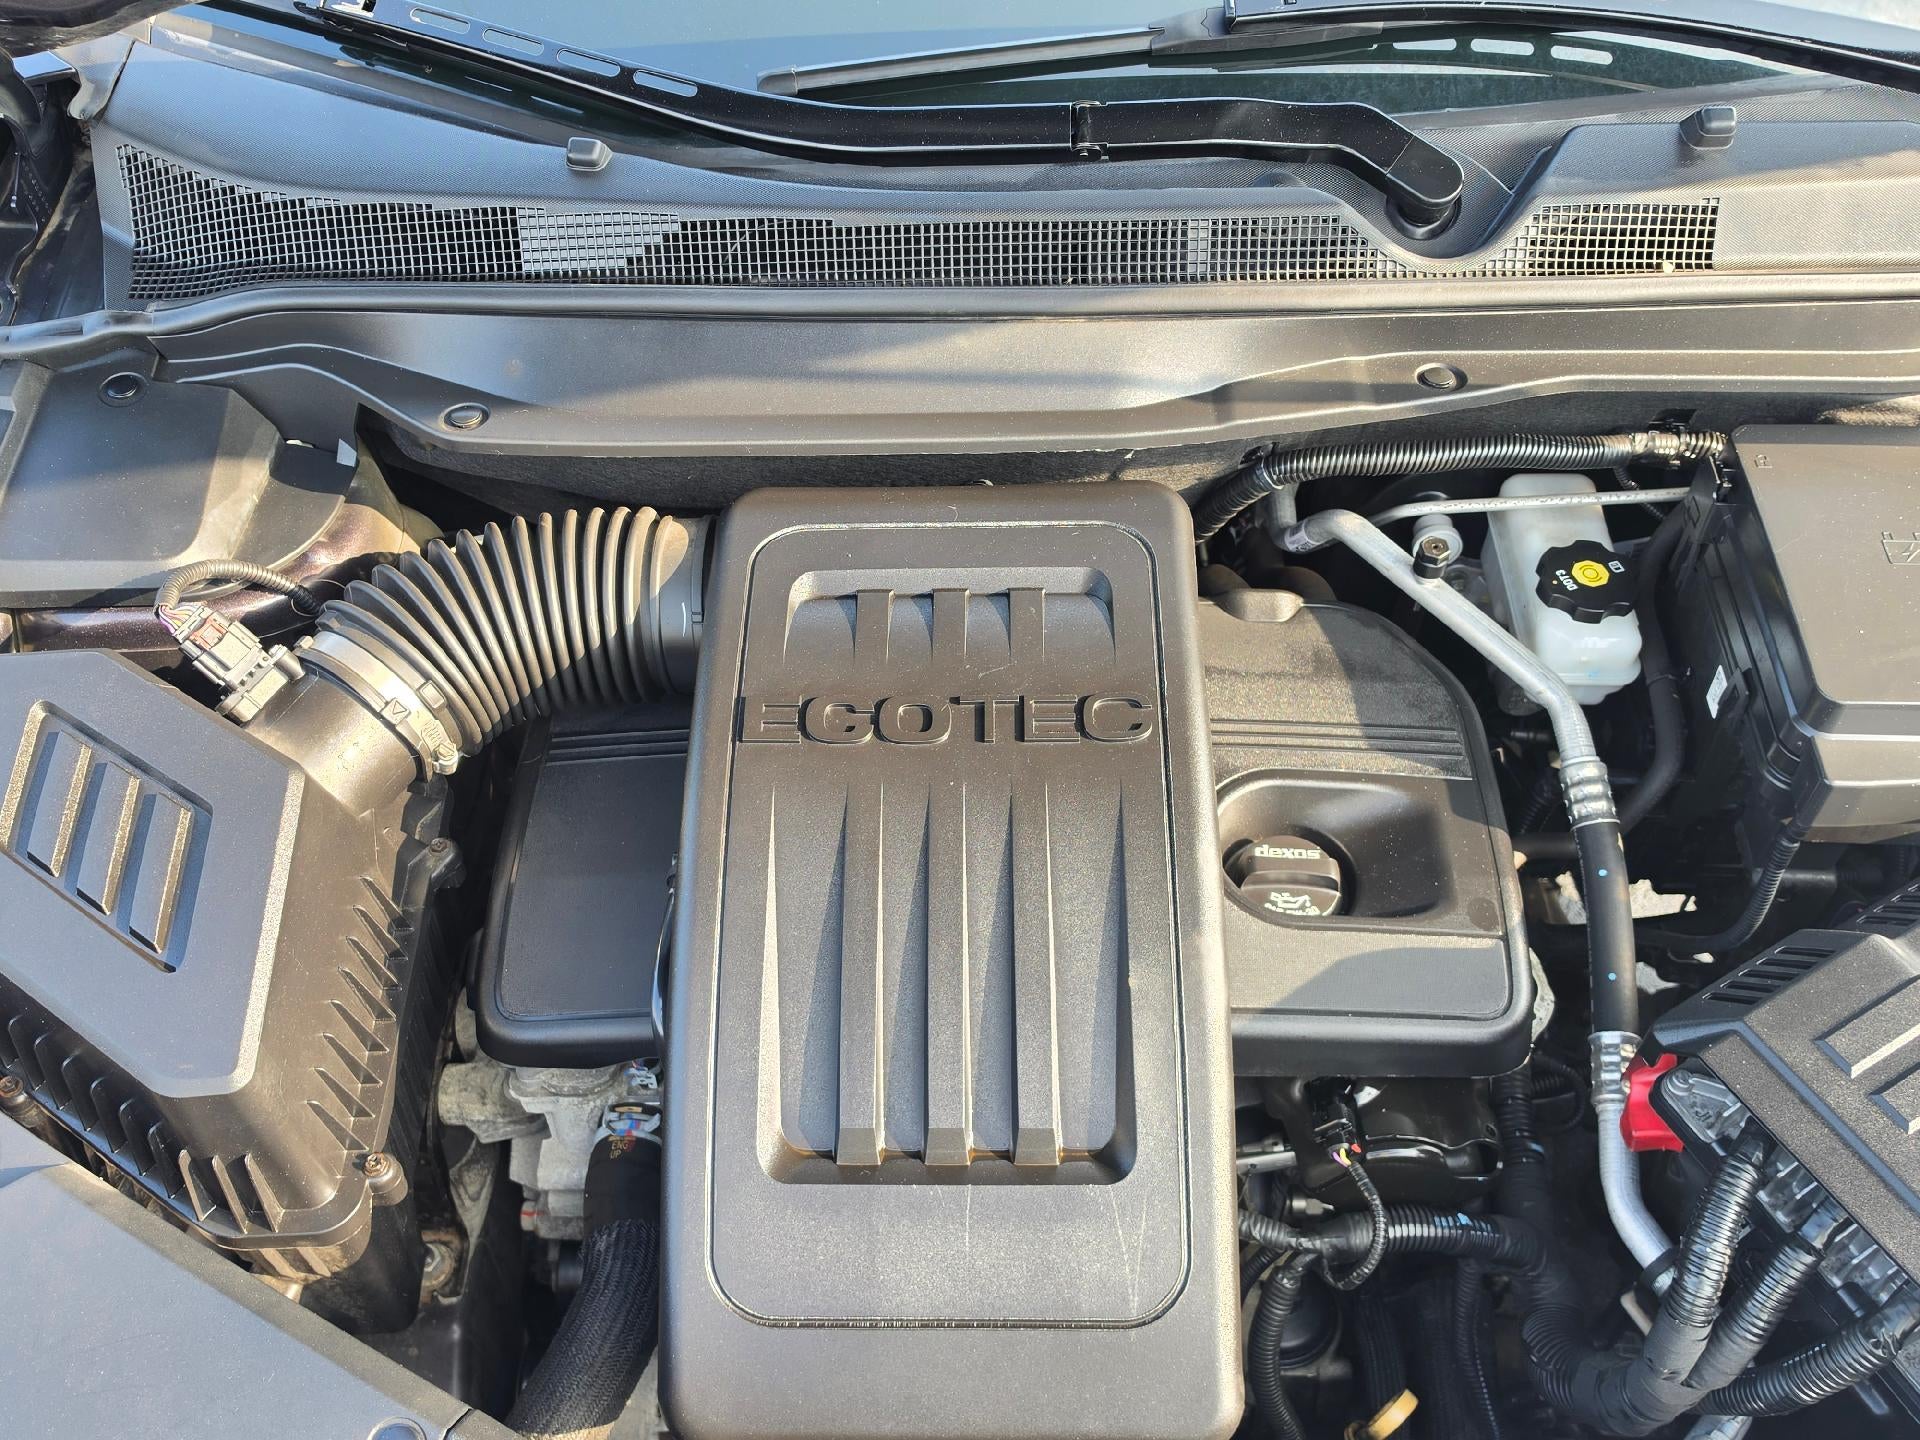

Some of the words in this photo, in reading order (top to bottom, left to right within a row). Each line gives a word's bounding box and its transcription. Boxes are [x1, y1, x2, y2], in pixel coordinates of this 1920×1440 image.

[1555, 569, 1579, 591] DOT3
[739, 693, 1153, 745] ECOTEC
[1254, 844, 1321, 859] dexos
[611, 1140, 629, 1150] ENG
[608, 1150, 622, 1159] UP
